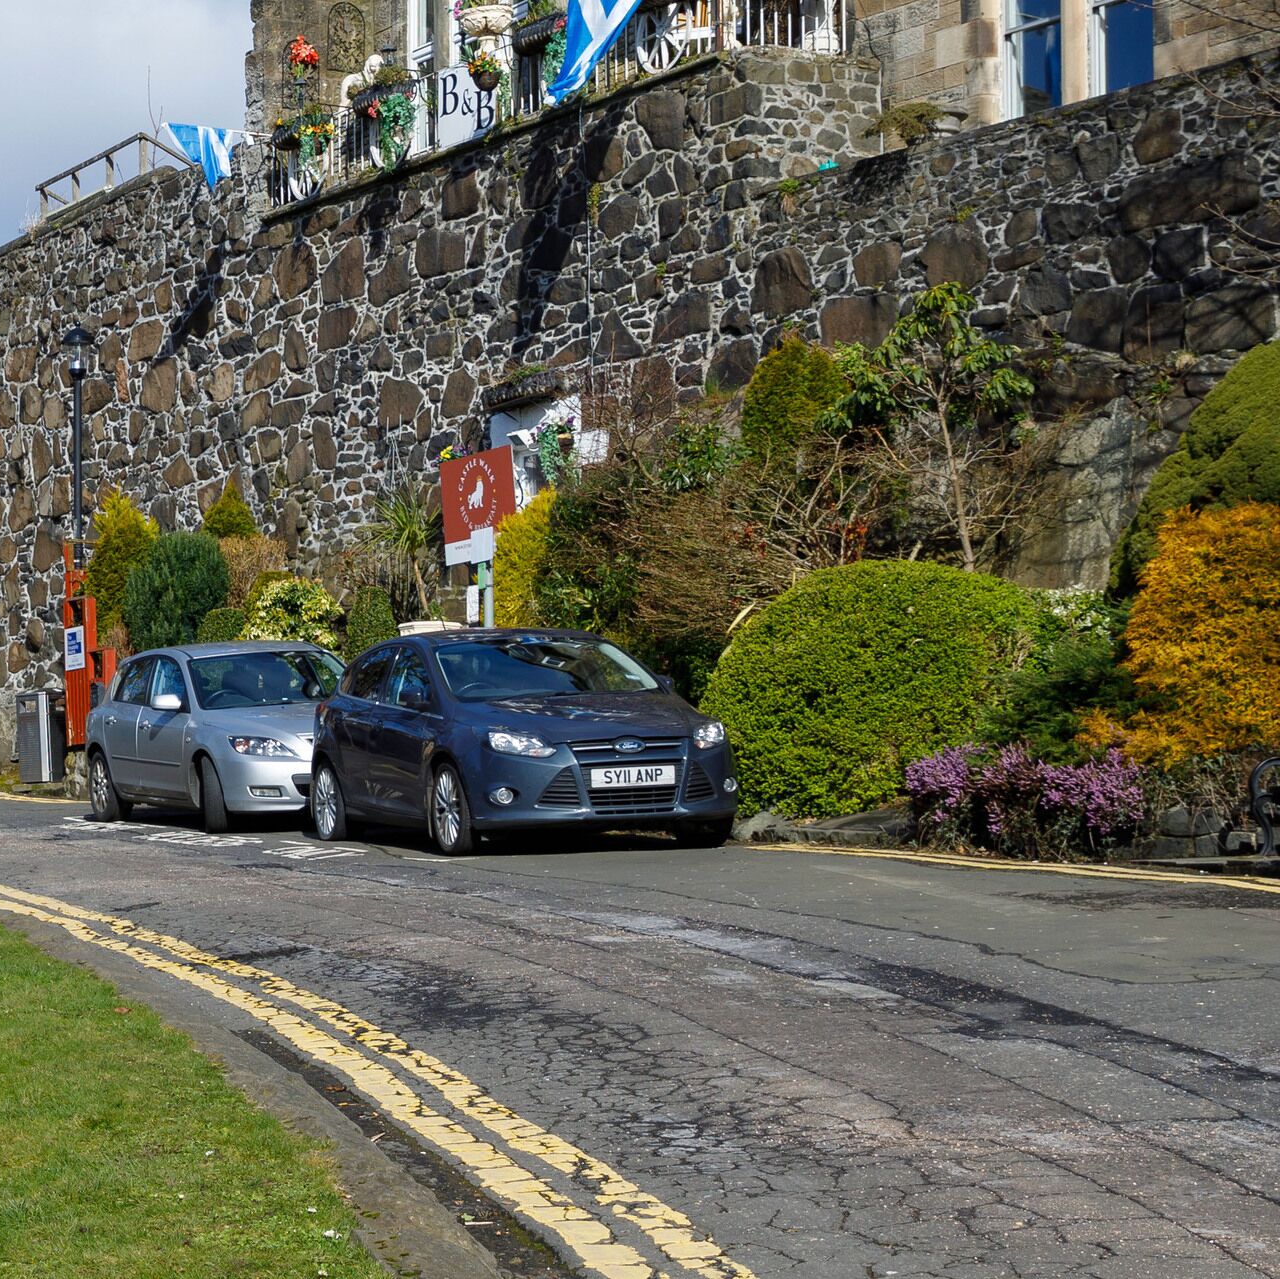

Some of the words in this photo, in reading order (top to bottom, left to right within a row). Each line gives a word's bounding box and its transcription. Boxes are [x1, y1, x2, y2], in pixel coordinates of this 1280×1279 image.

[457, 458, 478, 492] CASTLE
[479, 458, 496, 484] WALK
[635, 767, 663, 783] ANP
